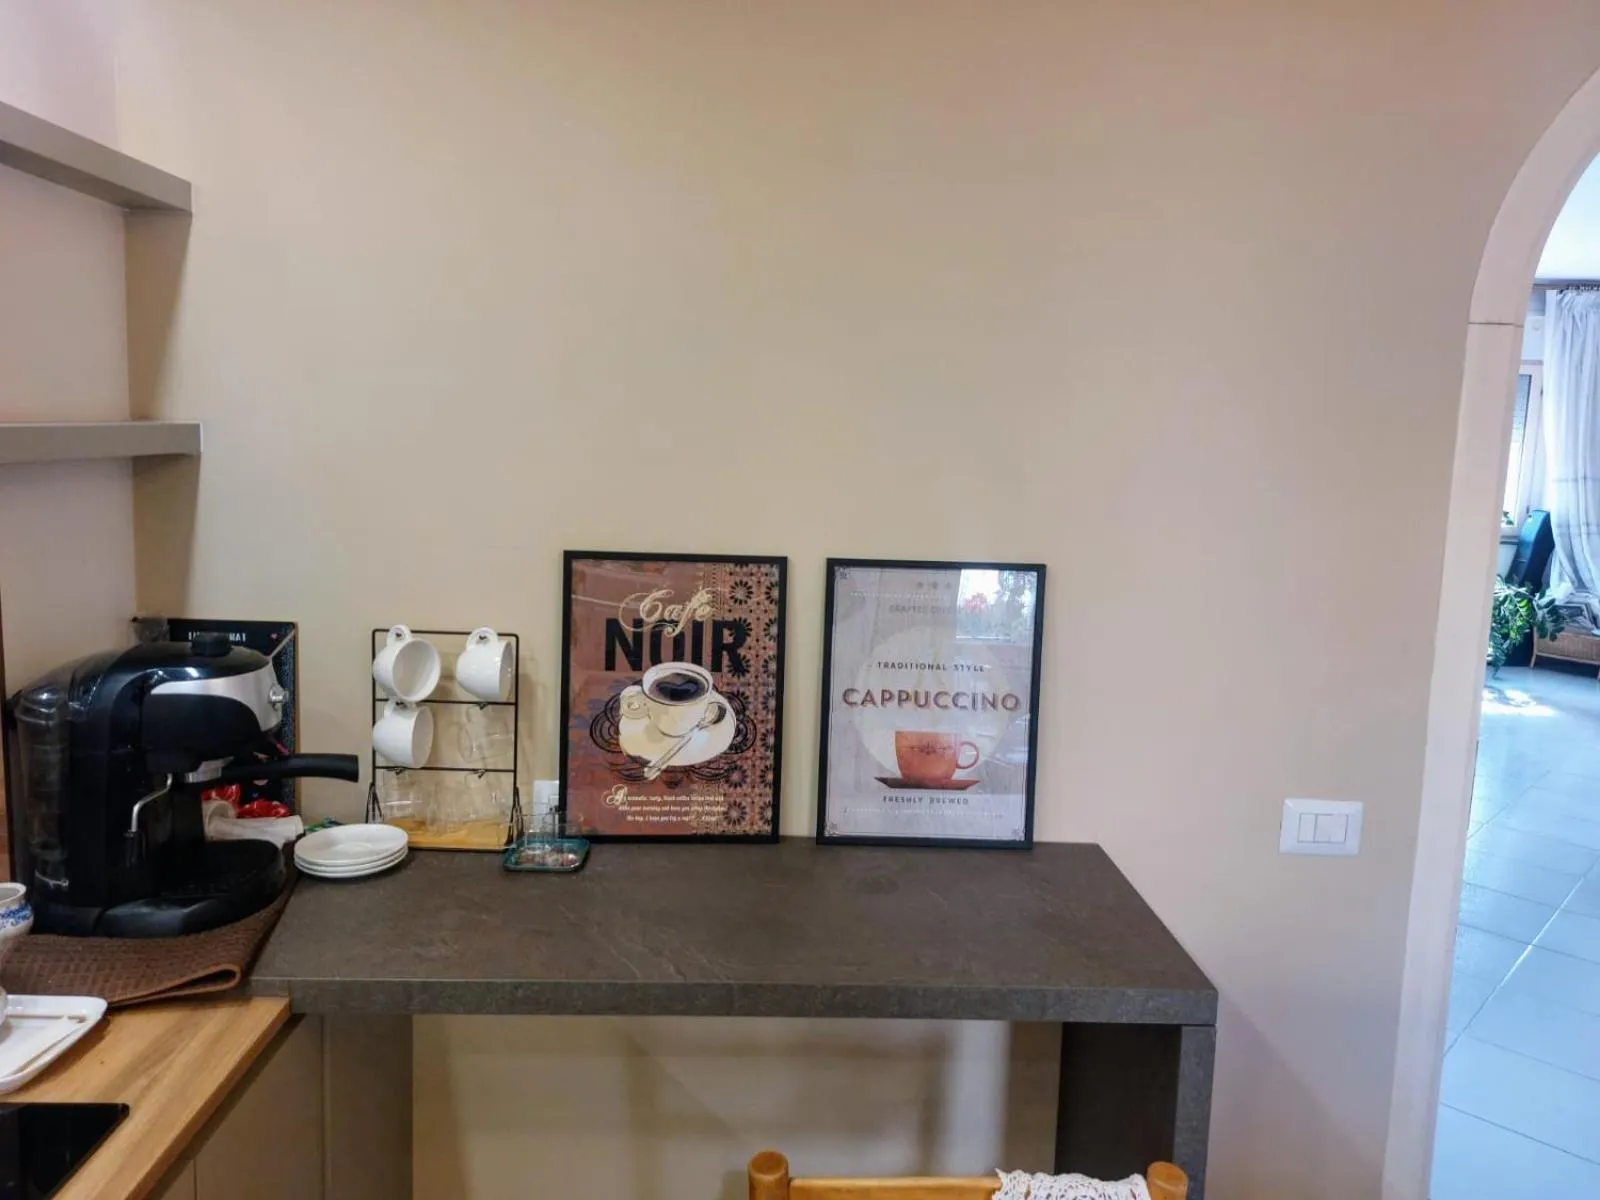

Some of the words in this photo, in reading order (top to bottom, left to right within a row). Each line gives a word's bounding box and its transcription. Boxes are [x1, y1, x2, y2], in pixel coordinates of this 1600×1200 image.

[605, 618, 747, 673] NOIR
[877, 661, 947, 671] TRADITIONAL
[953, 664, 985, 673] STYLE
[842, 687, 1022, 711] CAPPUCCINO
[882, 795, 924, 804] FRESHLY
[929, 797, 969, 806] BREWED
